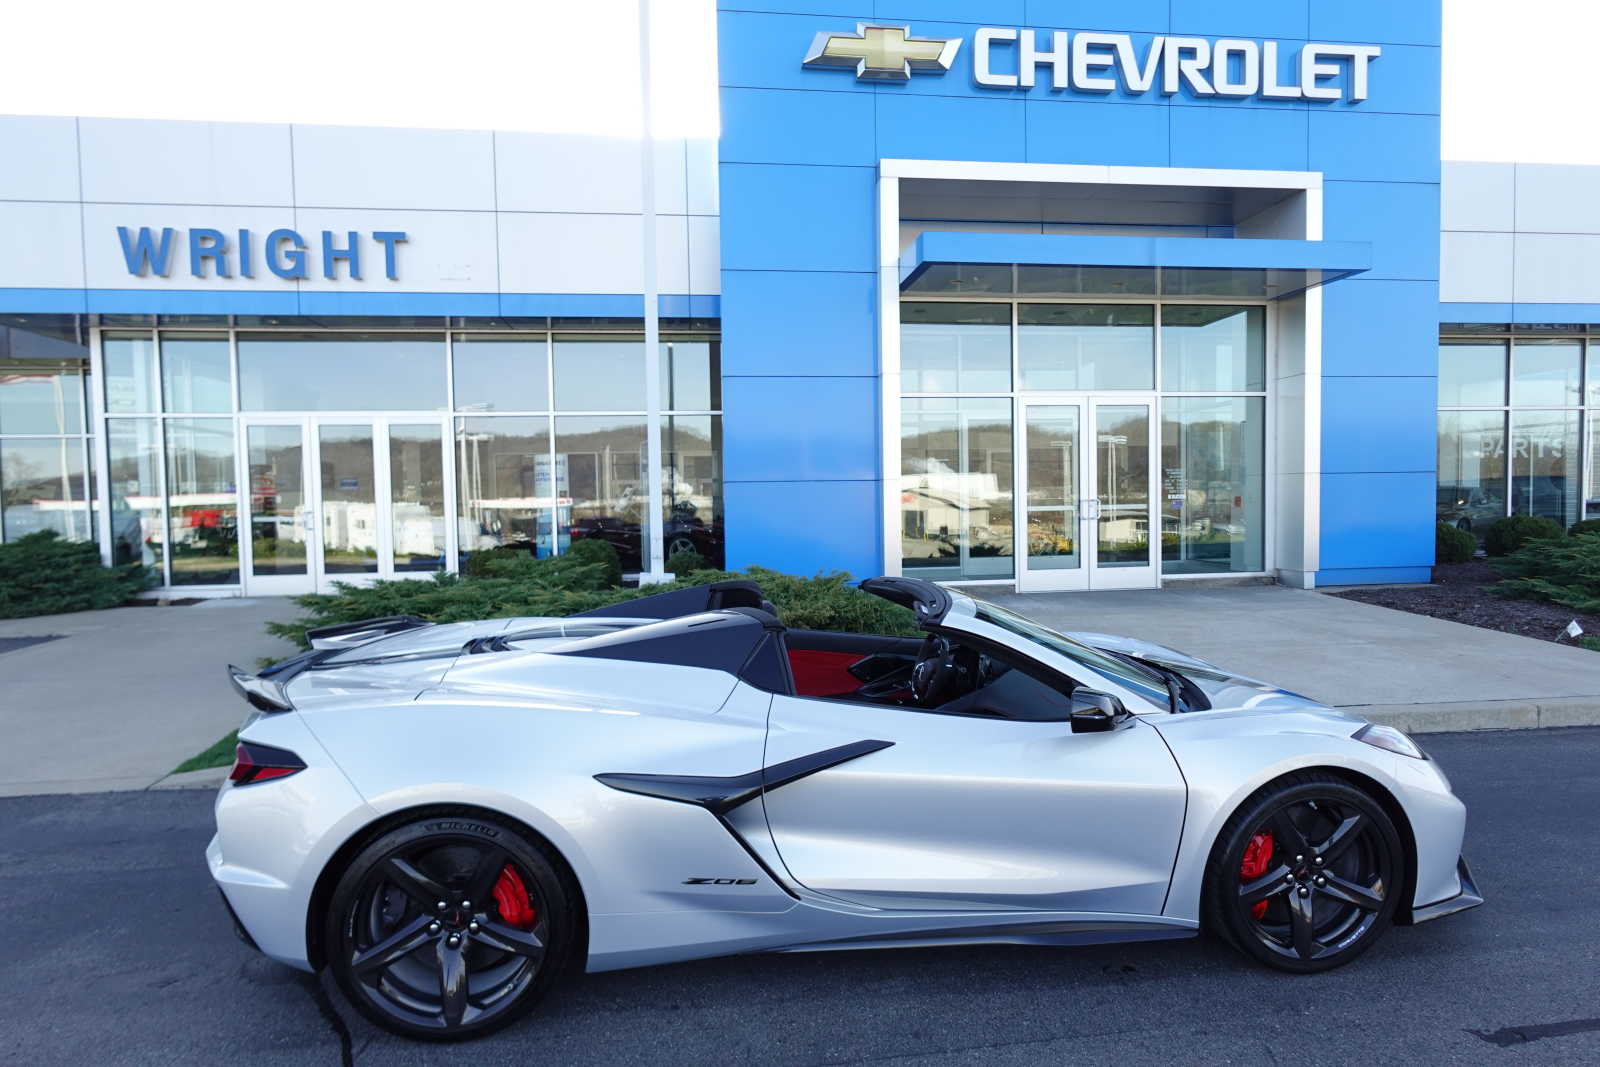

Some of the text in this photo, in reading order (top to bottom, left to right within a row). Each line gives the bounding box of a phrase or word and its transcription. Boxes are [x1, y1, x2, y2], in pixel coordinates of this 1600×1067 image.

[974, 27, 1381, 102] CHEVROLET
[117, 226, 408, 281] WRIGHT
[1480, 438, 1564, 458] PARTS
[681, 877, 758, 885] Z06
